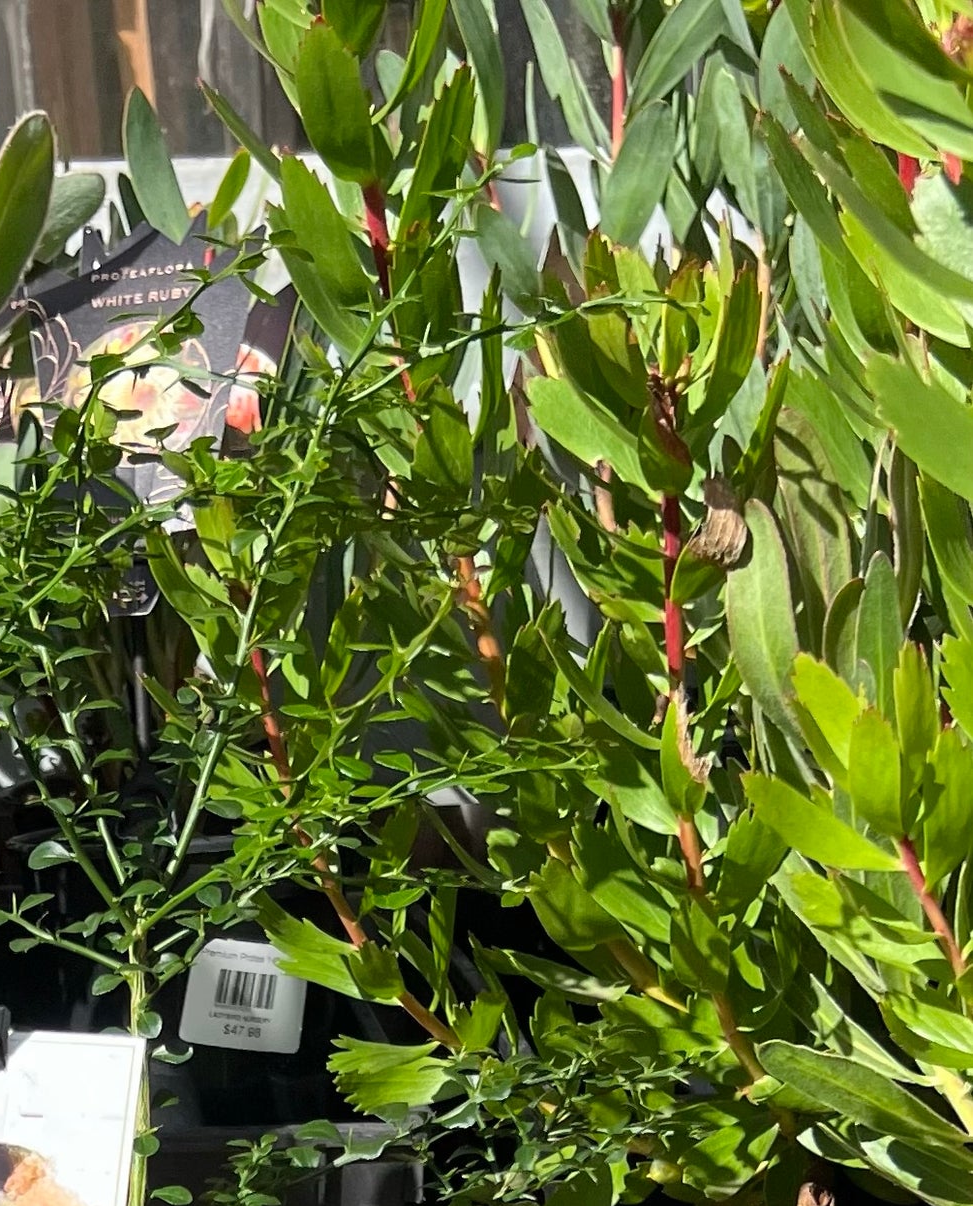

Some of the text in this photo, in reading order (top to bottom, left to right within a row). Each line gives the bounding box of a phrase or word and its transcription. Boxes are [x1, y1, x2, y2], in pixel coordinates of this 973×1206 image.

[90, 261, 194, 283] PROTEAFLORA
[91, 286, 194, 309] WHITE RUBY
